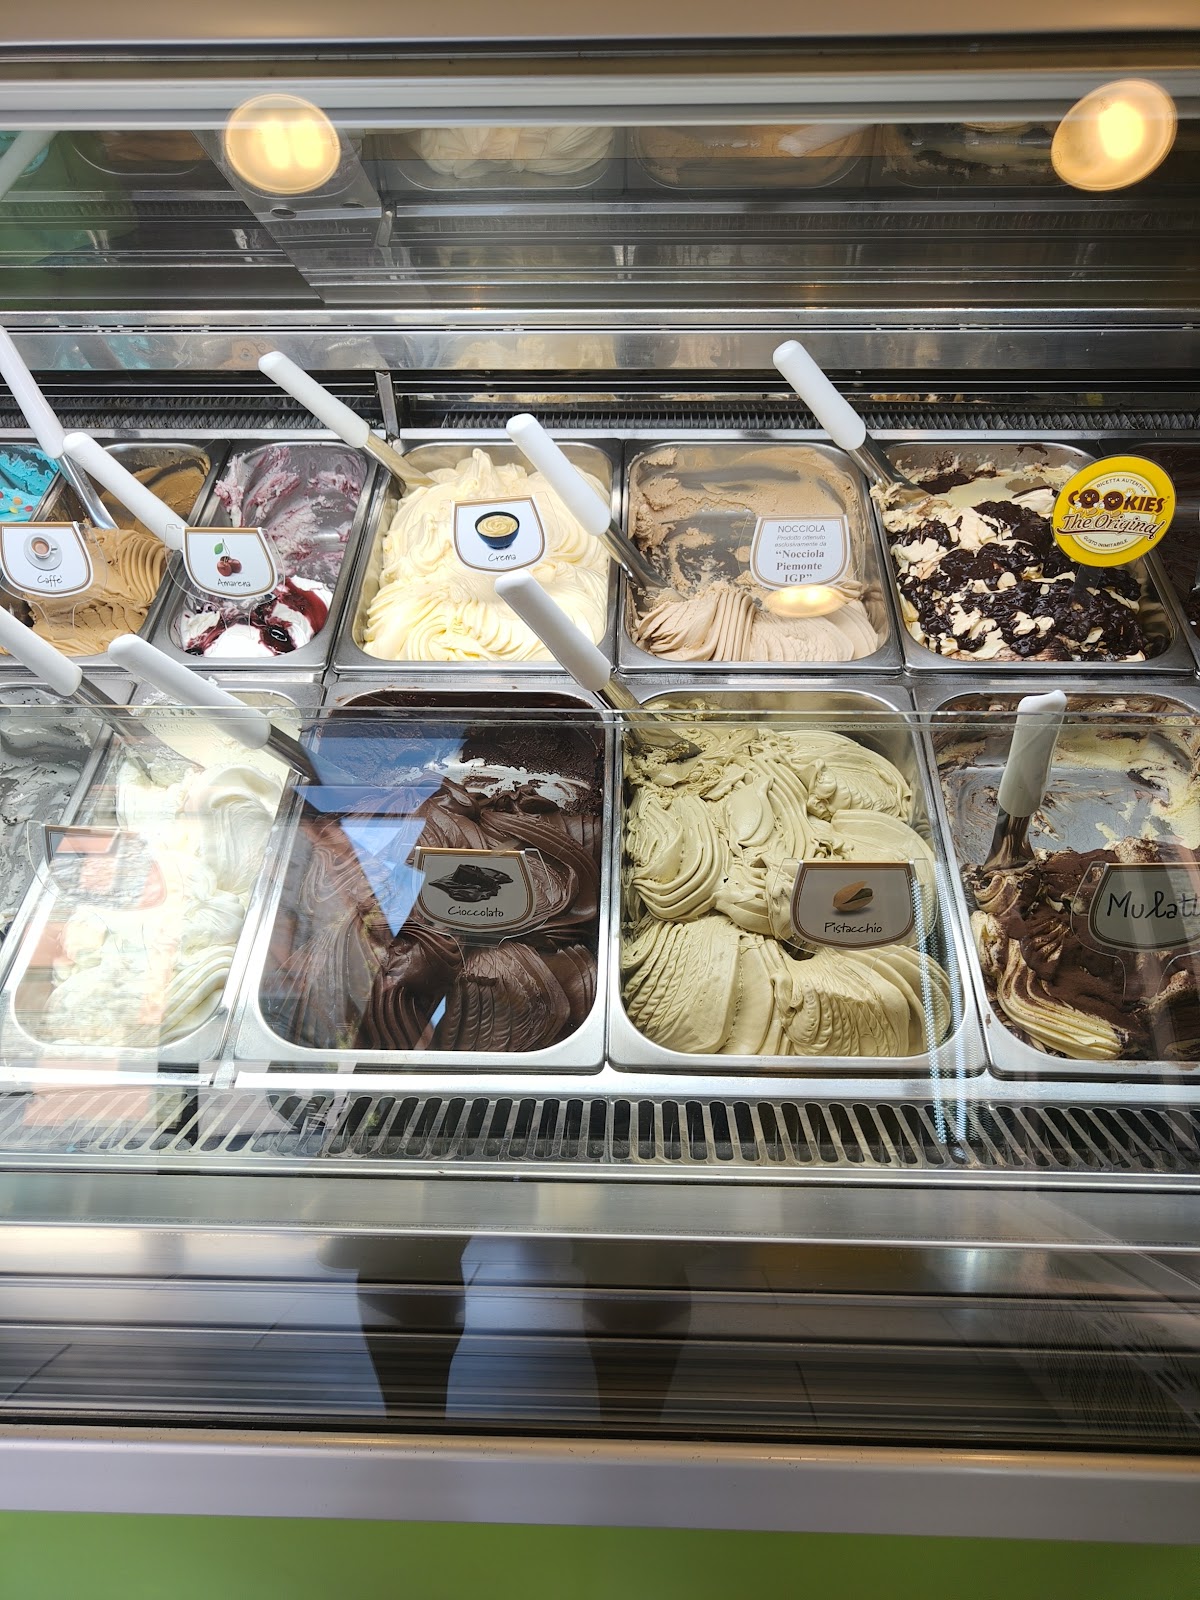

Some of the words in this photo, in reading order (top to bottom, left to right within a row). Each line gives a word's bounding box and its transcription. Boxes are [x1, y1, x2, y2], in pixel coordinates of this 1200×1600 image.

[1096, 477, 1120, 488] RICETTA
[1121, 477, 1148, 494] AUTENTICA
[777, 524, 826, 533] NOCCIOLA
[1063, 514, 1091, 529] The
[1094, 514, 1165, 540] Original
[1083, 535, 1098, 548] GUSTO
[1098, 538, 1129, 548] INIMITABILE
[487, 552, 517, 562] Crema
[776, 562, 823, 571] Piemonte
[217, 578, 251, 587] Amarena
[447, 905, 504, 917] Cioccolato
[824, 922, 883, 934] Pistacchio
